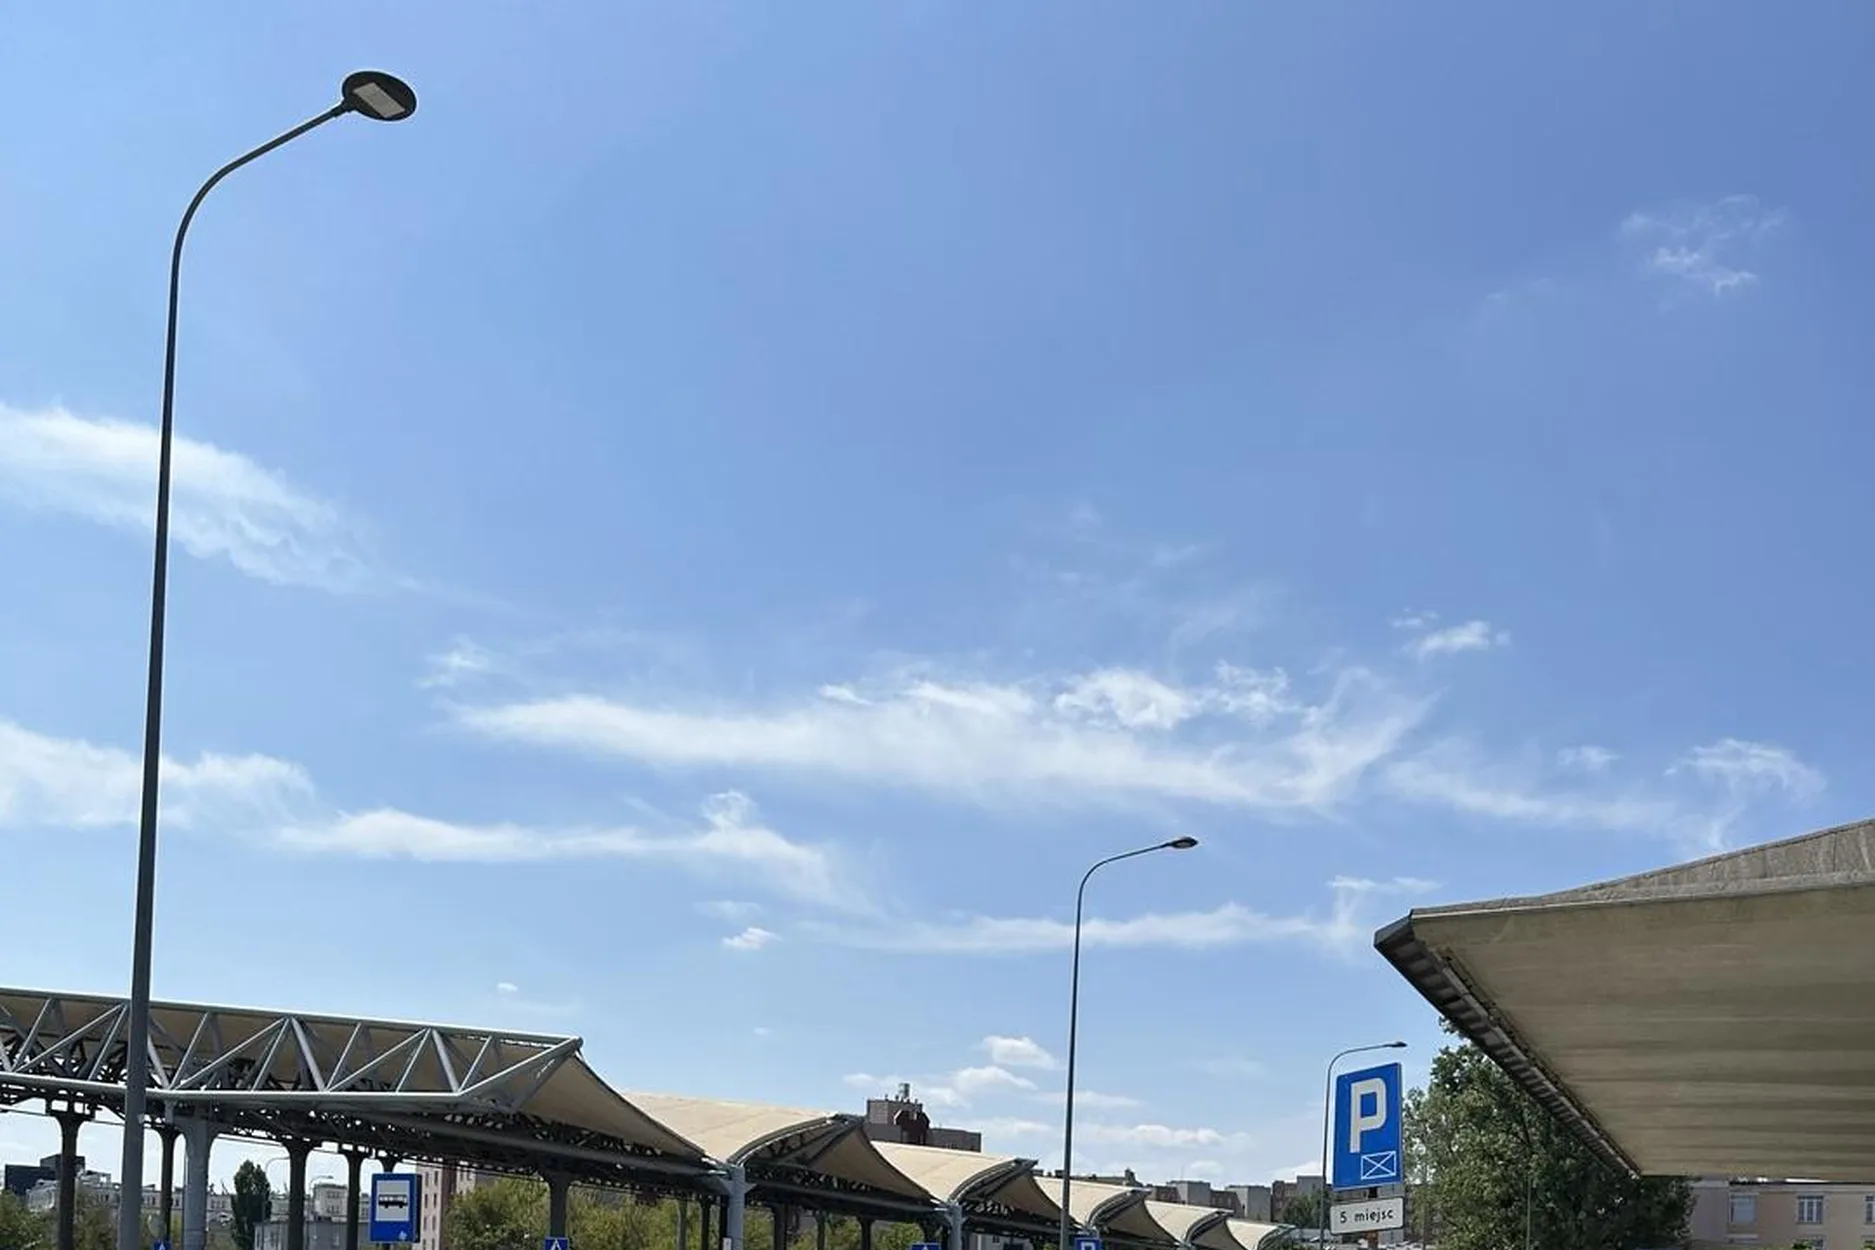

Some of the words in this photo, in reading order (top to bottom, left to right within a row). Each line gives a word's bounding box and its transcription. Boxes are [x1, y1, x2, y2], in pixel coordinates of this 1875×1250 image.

[1350, 1078, 1387, 1153] P
[1340, 1211, 1348, 1224] 5
[1354, 1208, 1394, 1224] miejsc
